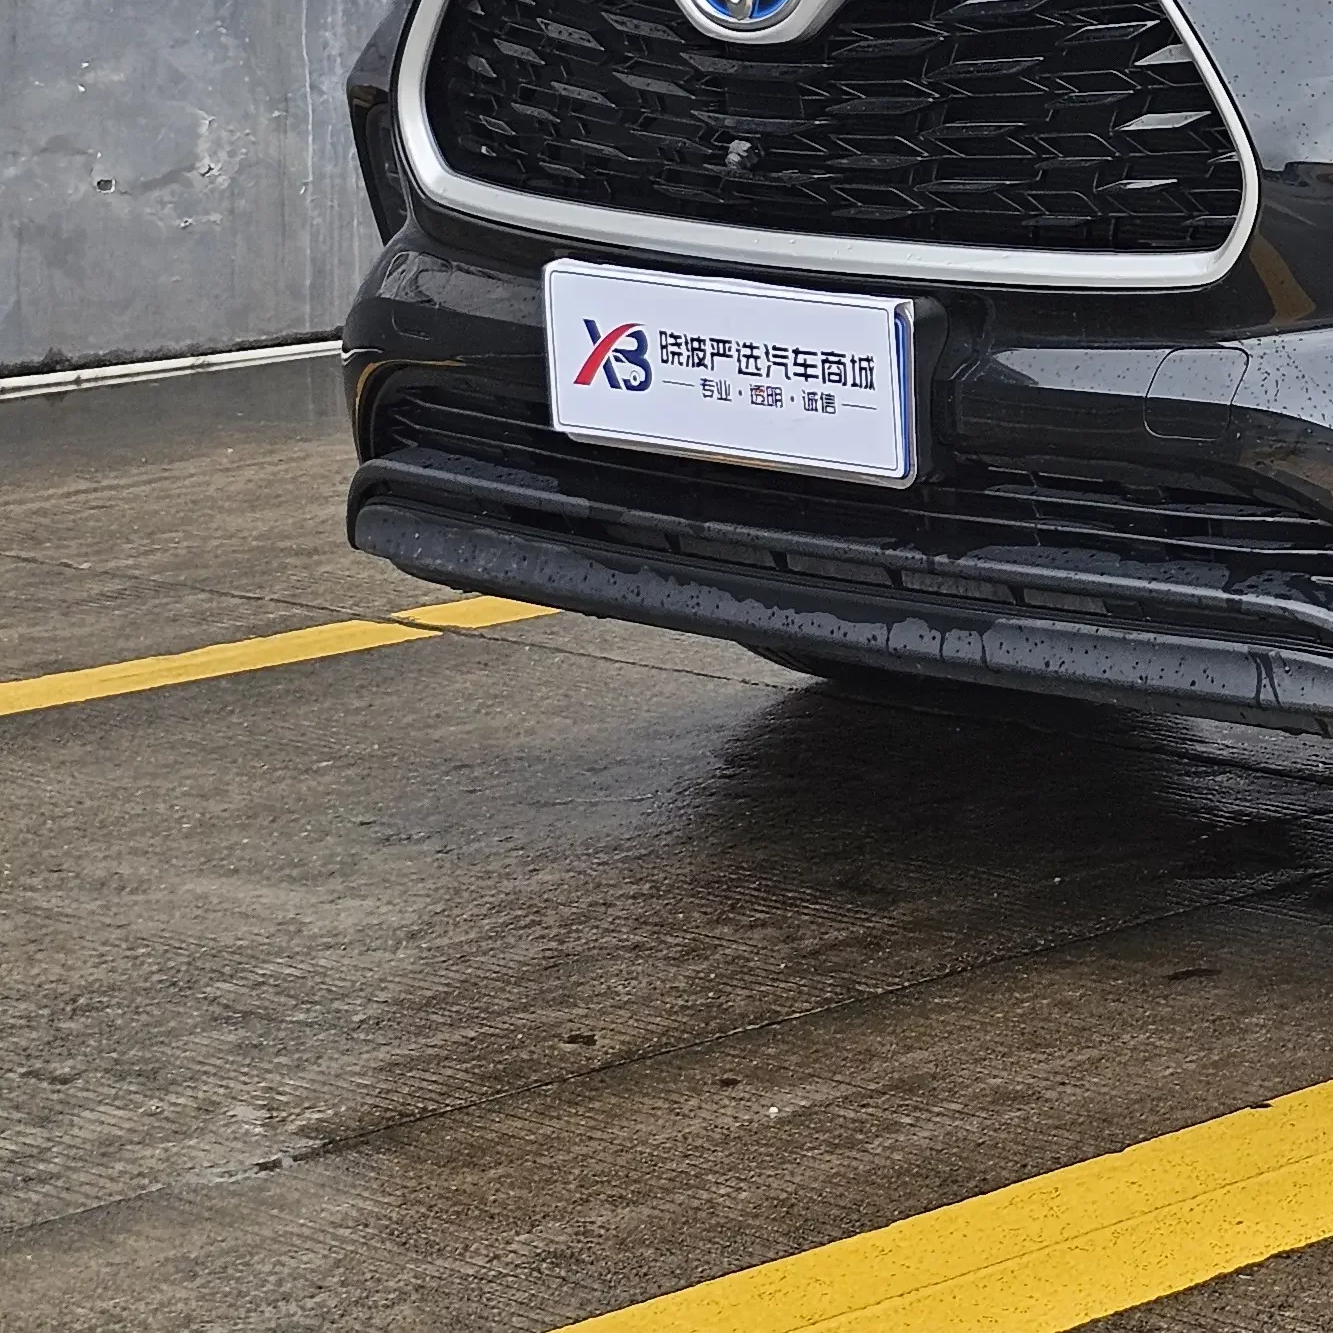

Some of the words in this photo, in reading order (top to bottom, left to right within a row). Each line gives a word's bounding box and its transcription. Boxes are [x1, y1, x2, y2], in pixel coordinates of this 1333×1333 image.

[659, 330, 876, 391] 晓波严选汽车商城
